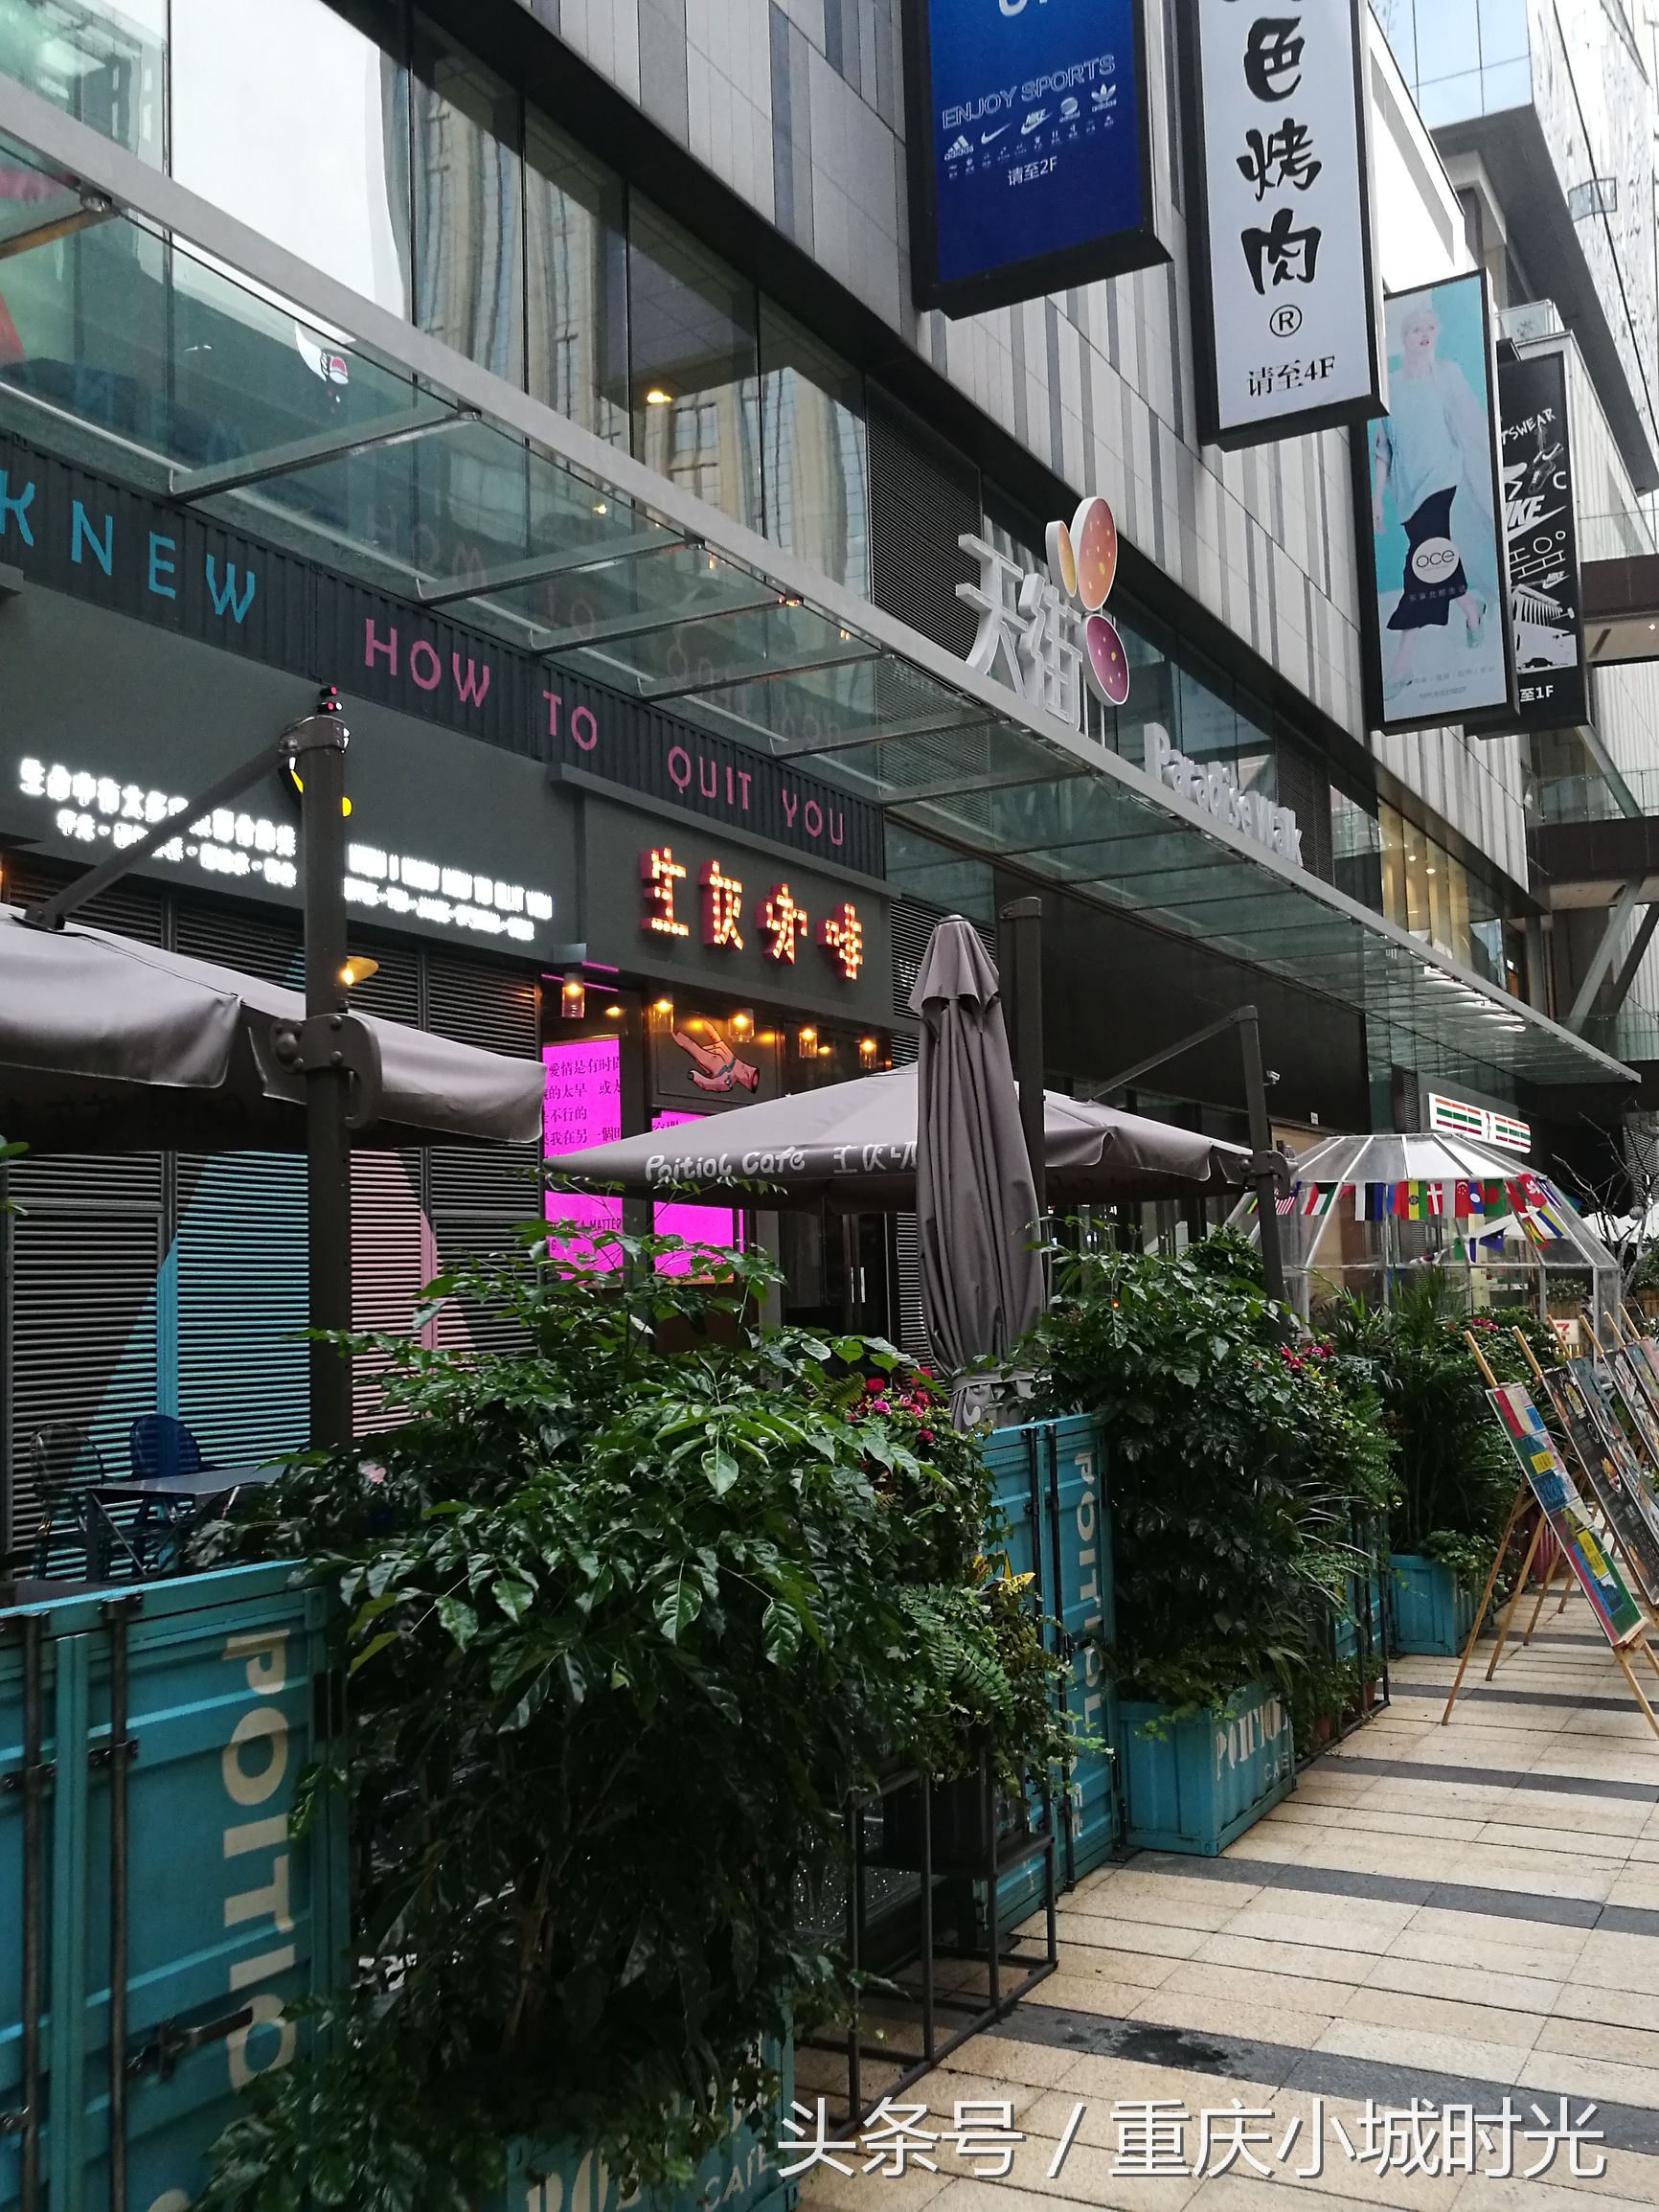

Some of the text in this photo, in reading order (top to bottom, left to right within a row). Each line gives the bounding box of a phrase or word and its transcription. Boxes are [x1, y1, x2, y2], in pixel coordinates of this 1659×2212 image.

[942, 85, 1017, 130] ENJOY
[1020, 53, 1115, 103] SPORTS
[944, 145, 975, 162] adidas
[1008, 155, 1057, 186] 请至2F
[1247, 354, 1336, 398] 请至4F
[1416, 549, 1455, 568] oce
[0, 469, 844, 846] KNEW HOW TO QUIT YOU
[544, 1104, 587, 1124] 不行的
[741, 1146, 806, 1175] Cafe
